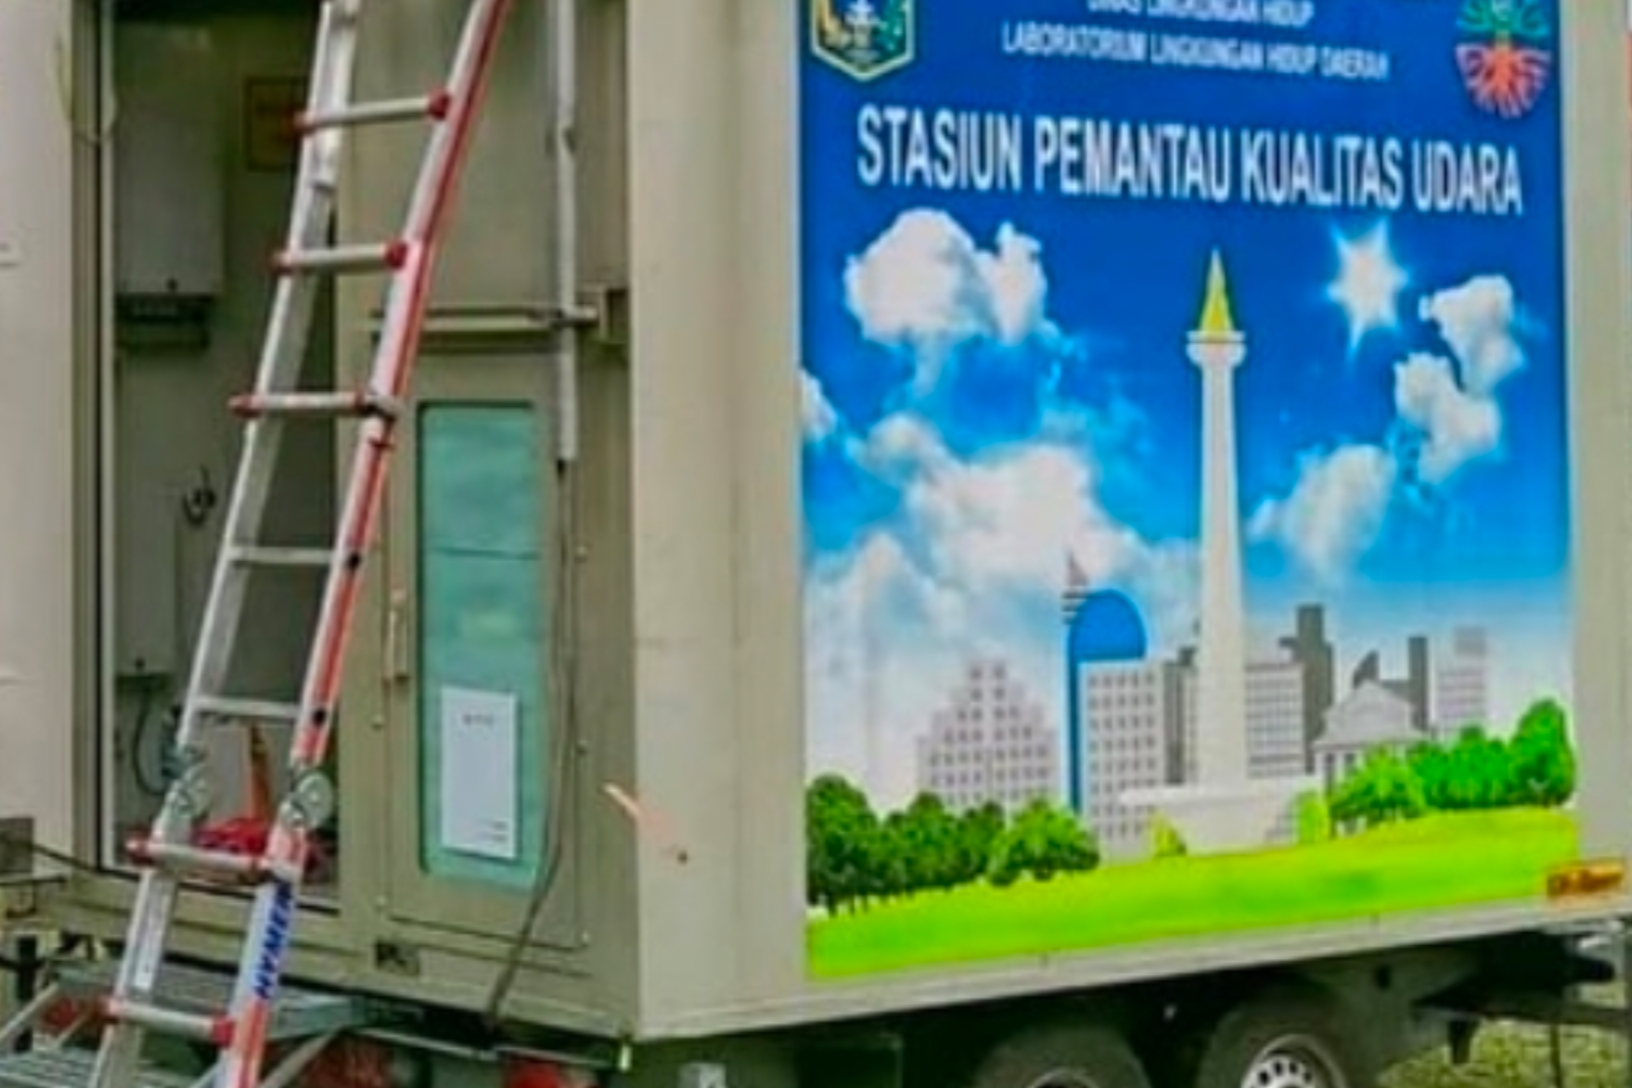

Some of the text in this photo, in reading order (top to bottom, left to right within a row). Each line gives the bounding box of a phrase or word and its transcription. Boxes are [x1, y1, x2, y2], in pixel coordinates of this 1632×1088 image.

[1002, 20, 1390, 82] LABORATORIUM LINGKUNGAN HIDUP DAERAH
[857, 105, 1523, 215] STASIUN PEMANTAU KUALITAS UDARA
